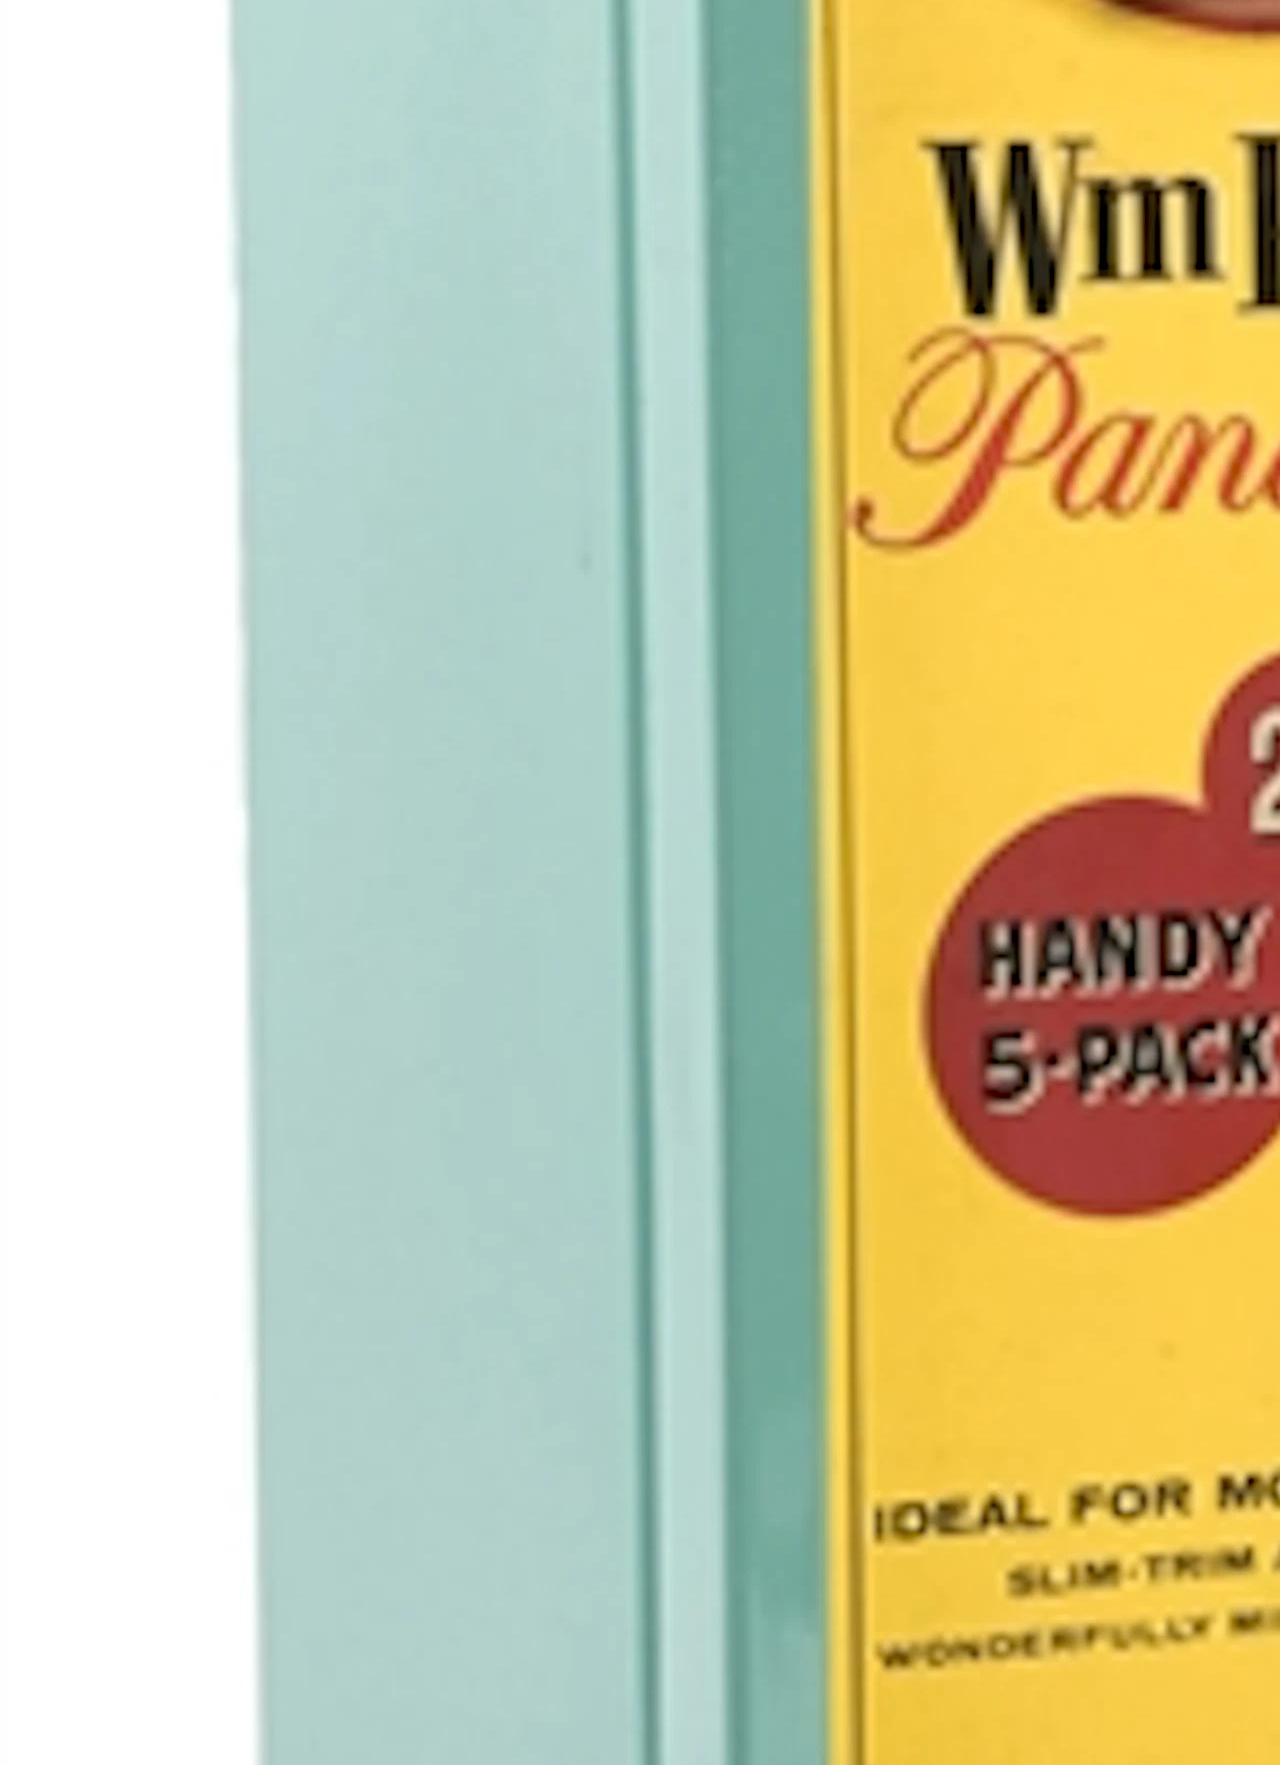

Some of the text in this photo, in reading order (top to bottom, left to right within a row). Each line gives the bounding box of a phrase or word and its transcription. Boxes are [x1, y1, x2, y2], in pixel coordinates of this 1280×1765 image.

[977, 907, 1271, 1001] HANDY
[874, 1492, 1050, 1543] IDEAL
[1071, 1477, 1192, 1528] FOR
[877, 1613, 1213, 1672] WONDERFULLY
